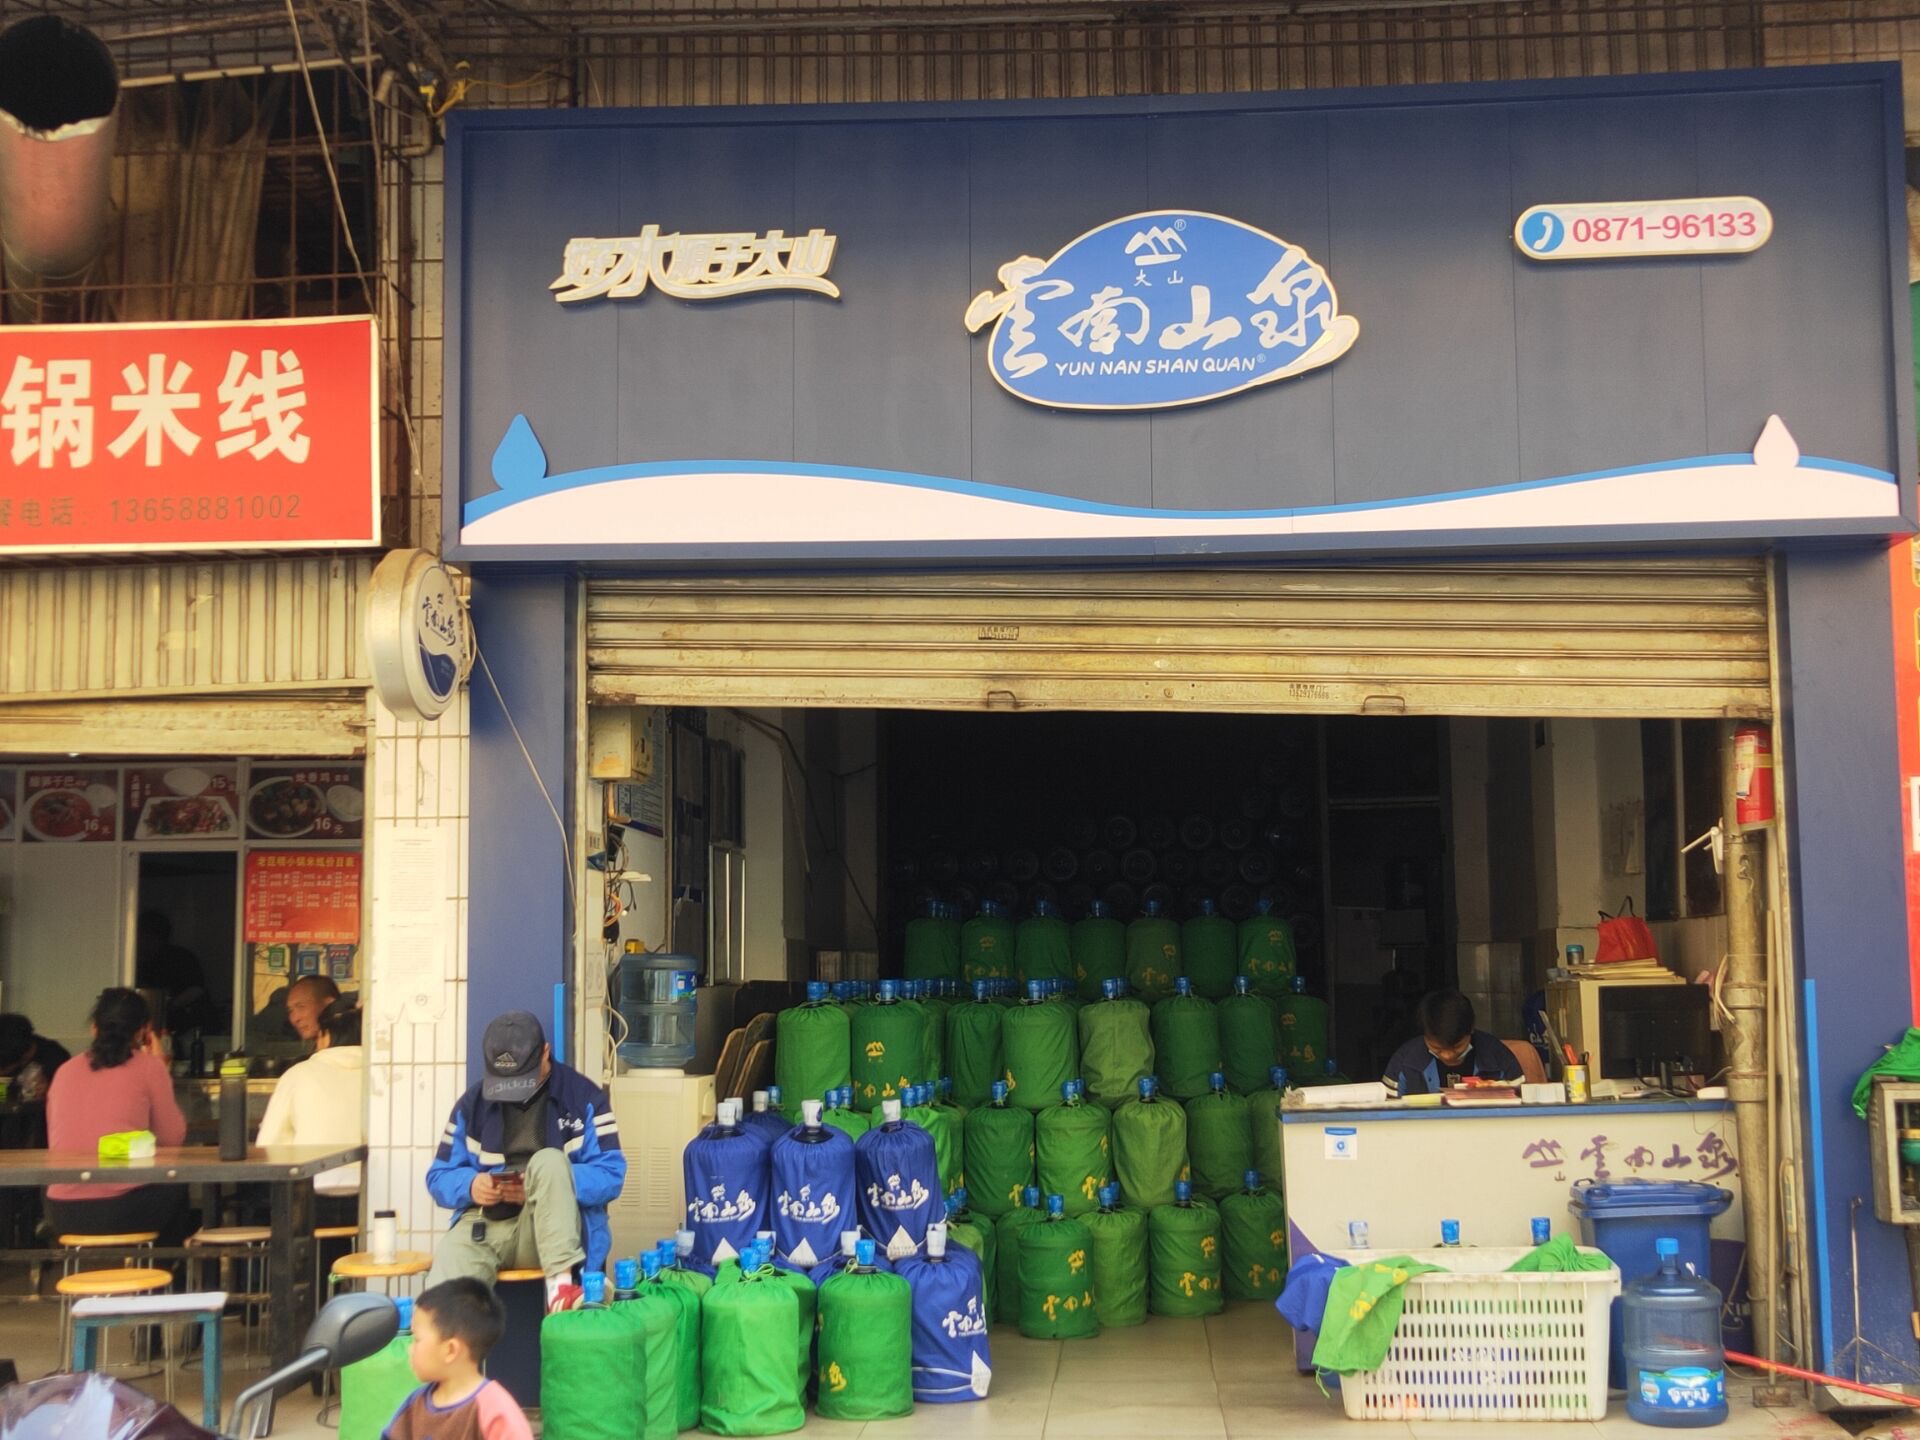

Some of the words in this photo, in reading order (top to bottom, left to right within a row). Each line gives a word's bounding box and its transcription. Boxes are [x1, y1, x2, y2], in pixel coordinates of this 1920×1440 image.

[1572, 212, 1756, 243] 0871-96133
[1133, 268, 1185, 288] 大山
[1055, 360, 1095, 376] YUN
[1099, 360, 1141, 376] NAN
[1145, 358, 1200, 375] SHAN
[1202, 357, 1256, 373] QUAN
[1, 350, 310, 468] 锅米线
[110, 494, 302, 523] 13658881002
[211, 776, 226, 789] 15
[84, 818, 99, 832] 16
[315, 817, 331, 831] 16
